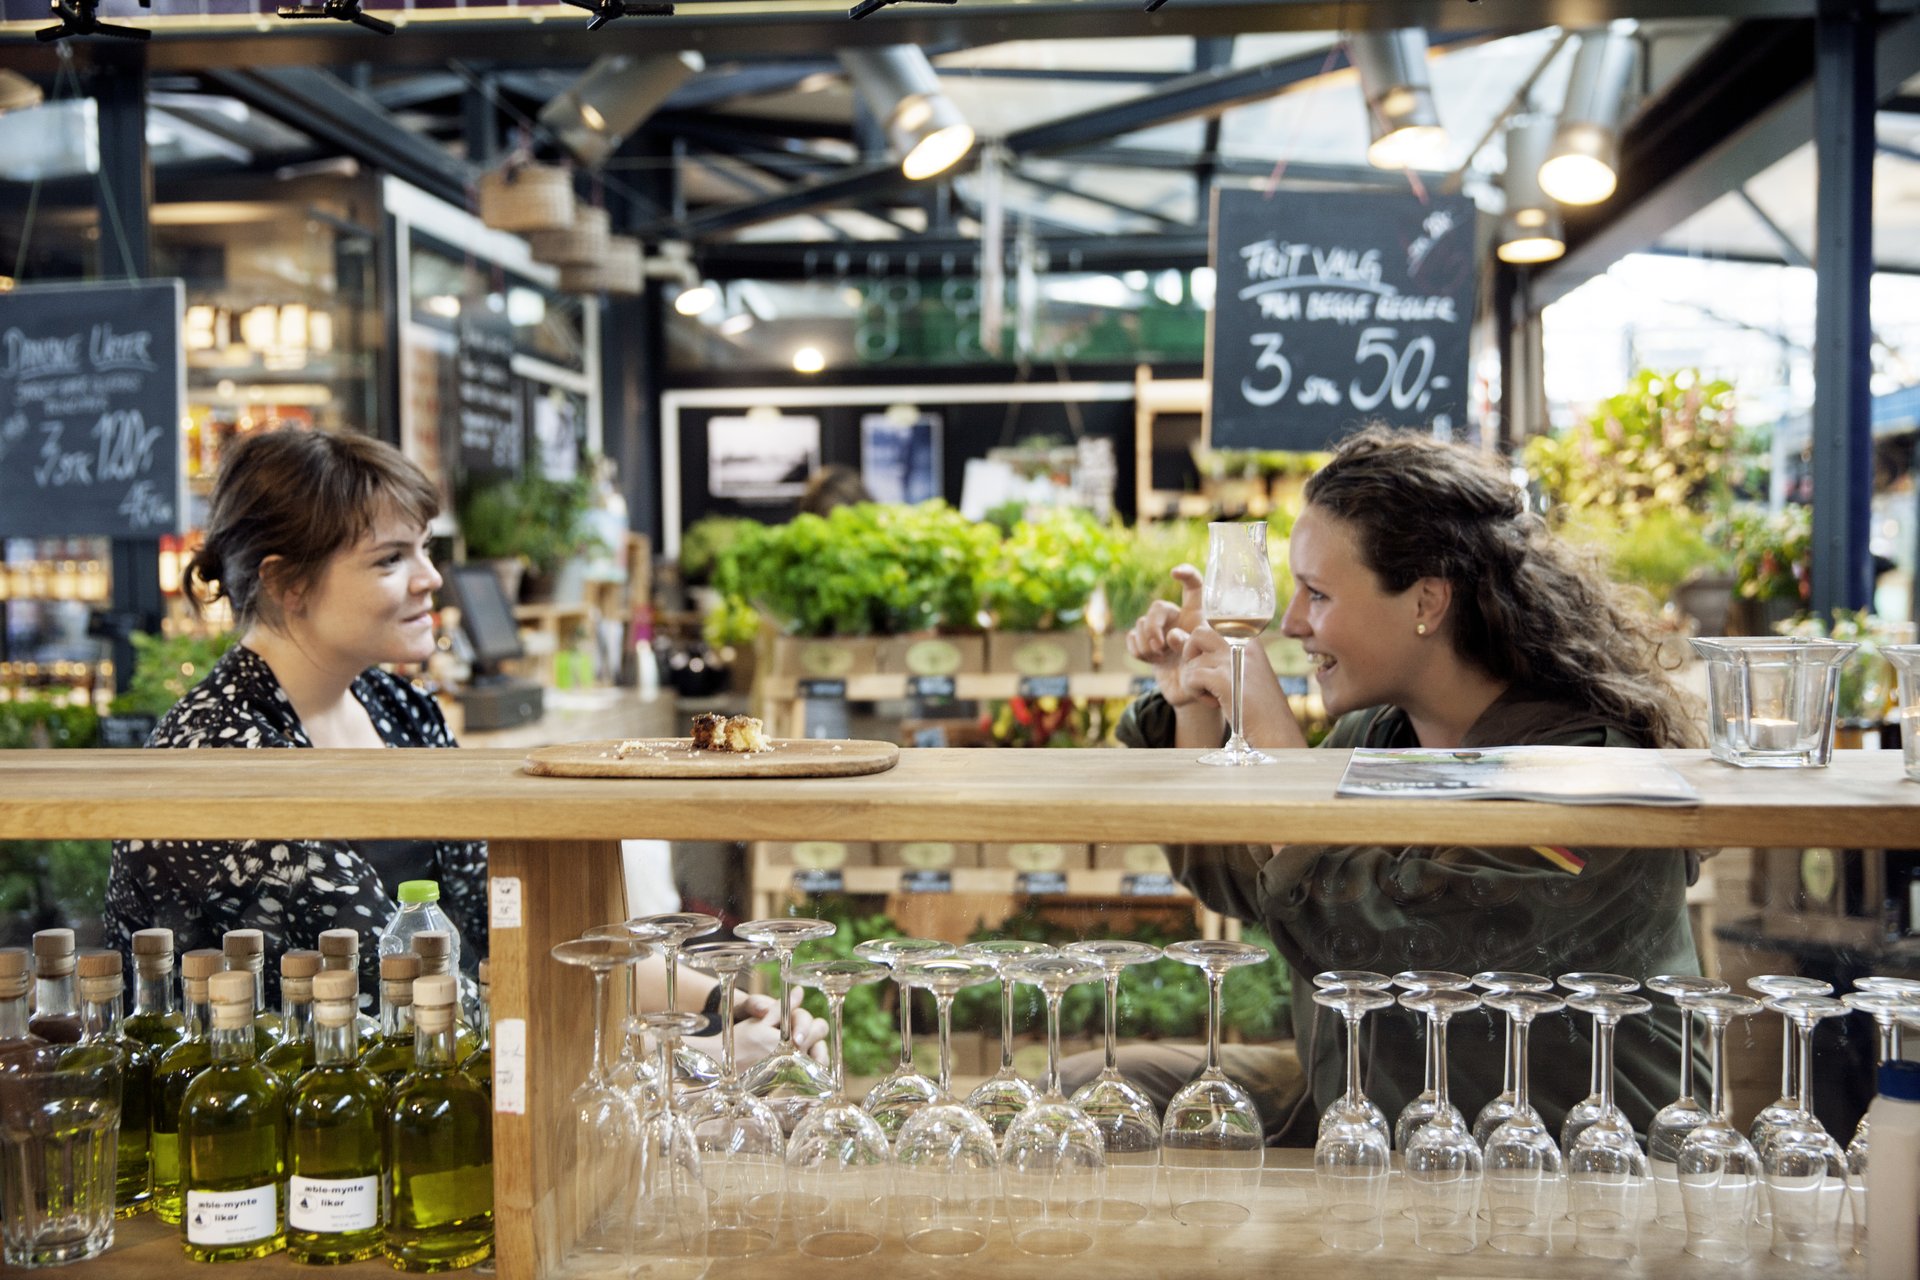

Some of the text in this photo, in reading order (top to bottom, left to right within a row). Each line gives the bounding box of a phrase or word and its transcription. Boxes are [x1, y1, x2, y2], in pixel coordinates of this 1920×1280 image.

[1312, 246, 1382, 288] VALG
[1241, 332, 1292, 407] 3
[34, 420, 64, 487] 3
[305, 1184, 364, 1195] æble-mynte
[198, 1198, 258, 1209] æble-mynte
[321, 1198, 345, 1207] likør
[214, 1213, 239, 1222] likør
